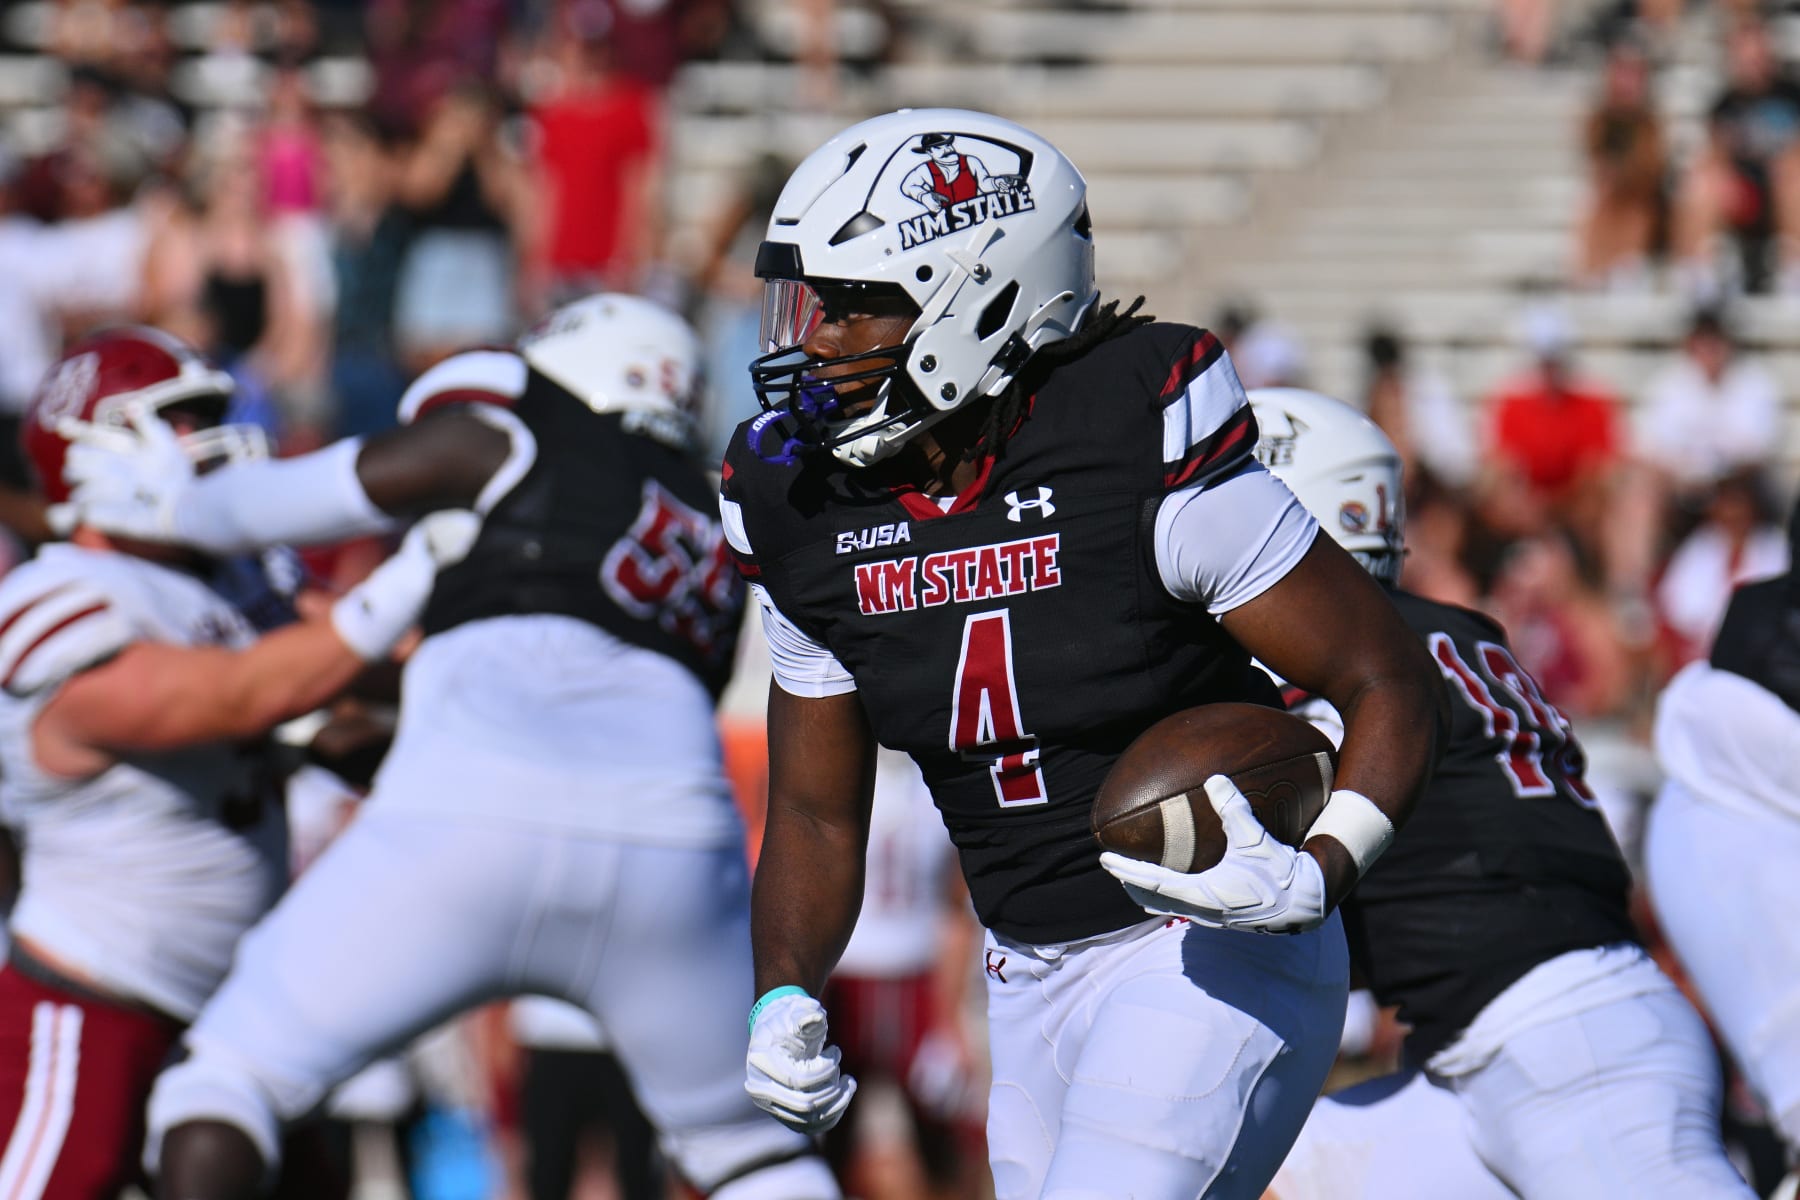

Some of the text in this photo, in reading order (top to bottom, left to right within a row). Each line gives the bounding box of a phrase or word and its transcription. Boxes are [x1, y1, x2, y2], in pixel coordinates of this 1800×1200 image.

[899, 183, 1035, 250] NM STATE
[854, 532, 1062, 616] NM STATE
[948, 607, 1048, 808] 4
